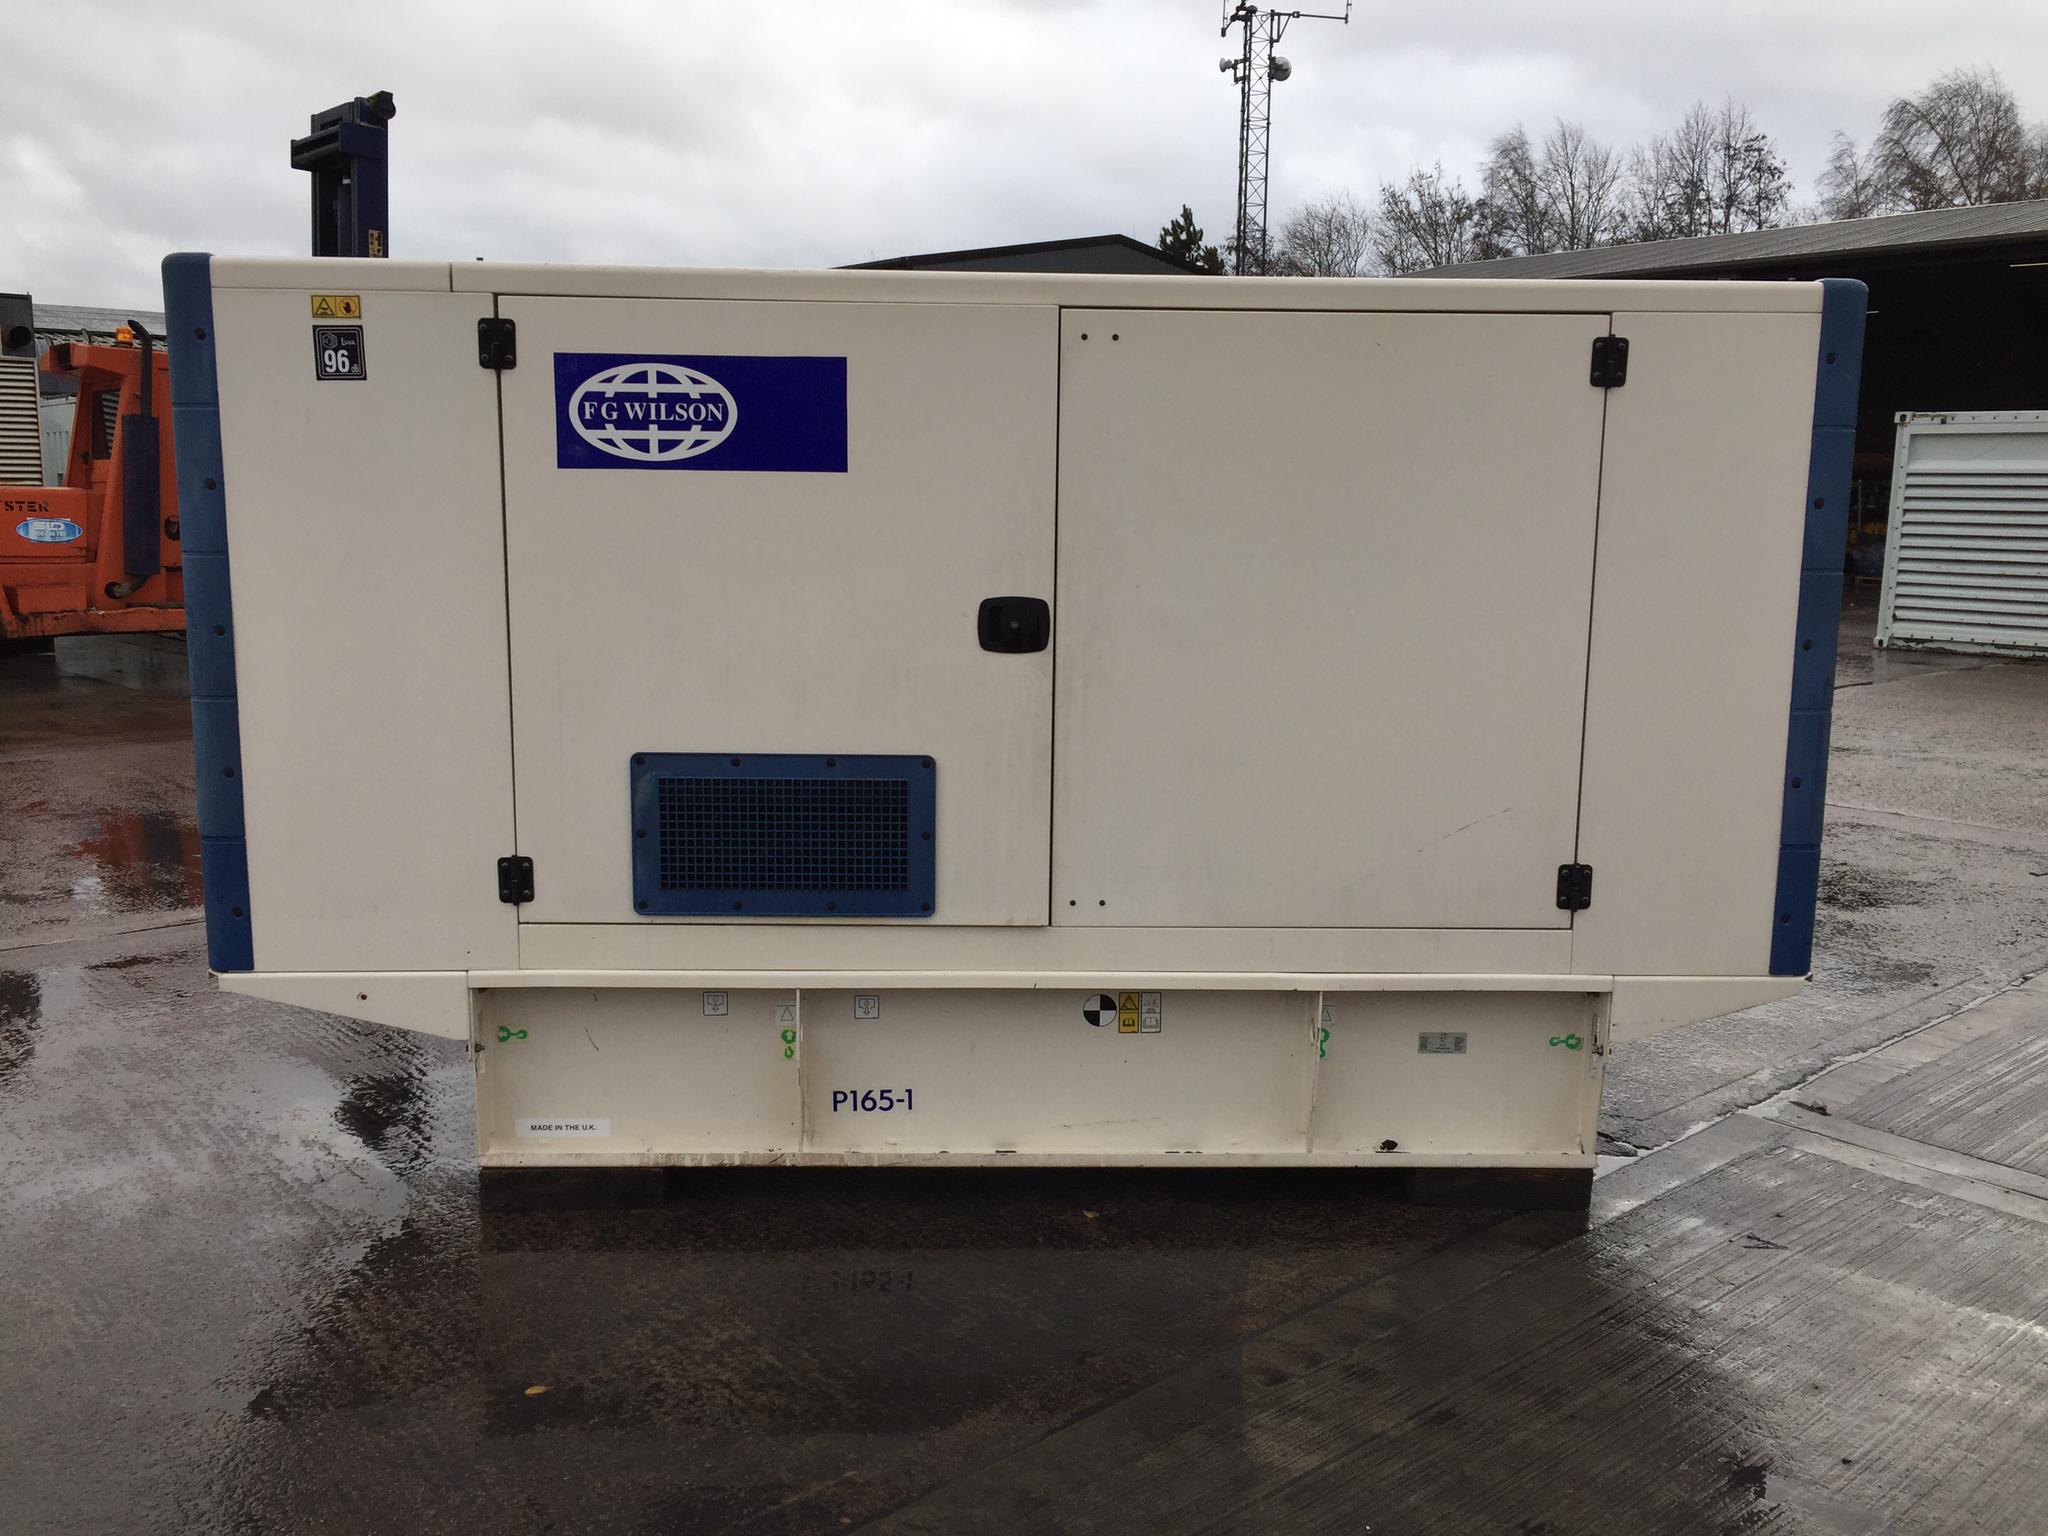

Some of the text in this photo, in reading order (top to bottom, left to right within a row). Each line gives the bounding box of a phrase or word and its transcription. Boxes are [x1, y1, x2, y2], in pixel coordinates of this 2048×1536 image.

[324, 349, 350, 373] 96
[624, 402, 724, 422] WILSON
[0, 500, 49, 512] STER
[832, 1088, 913, 1112] P165-1
